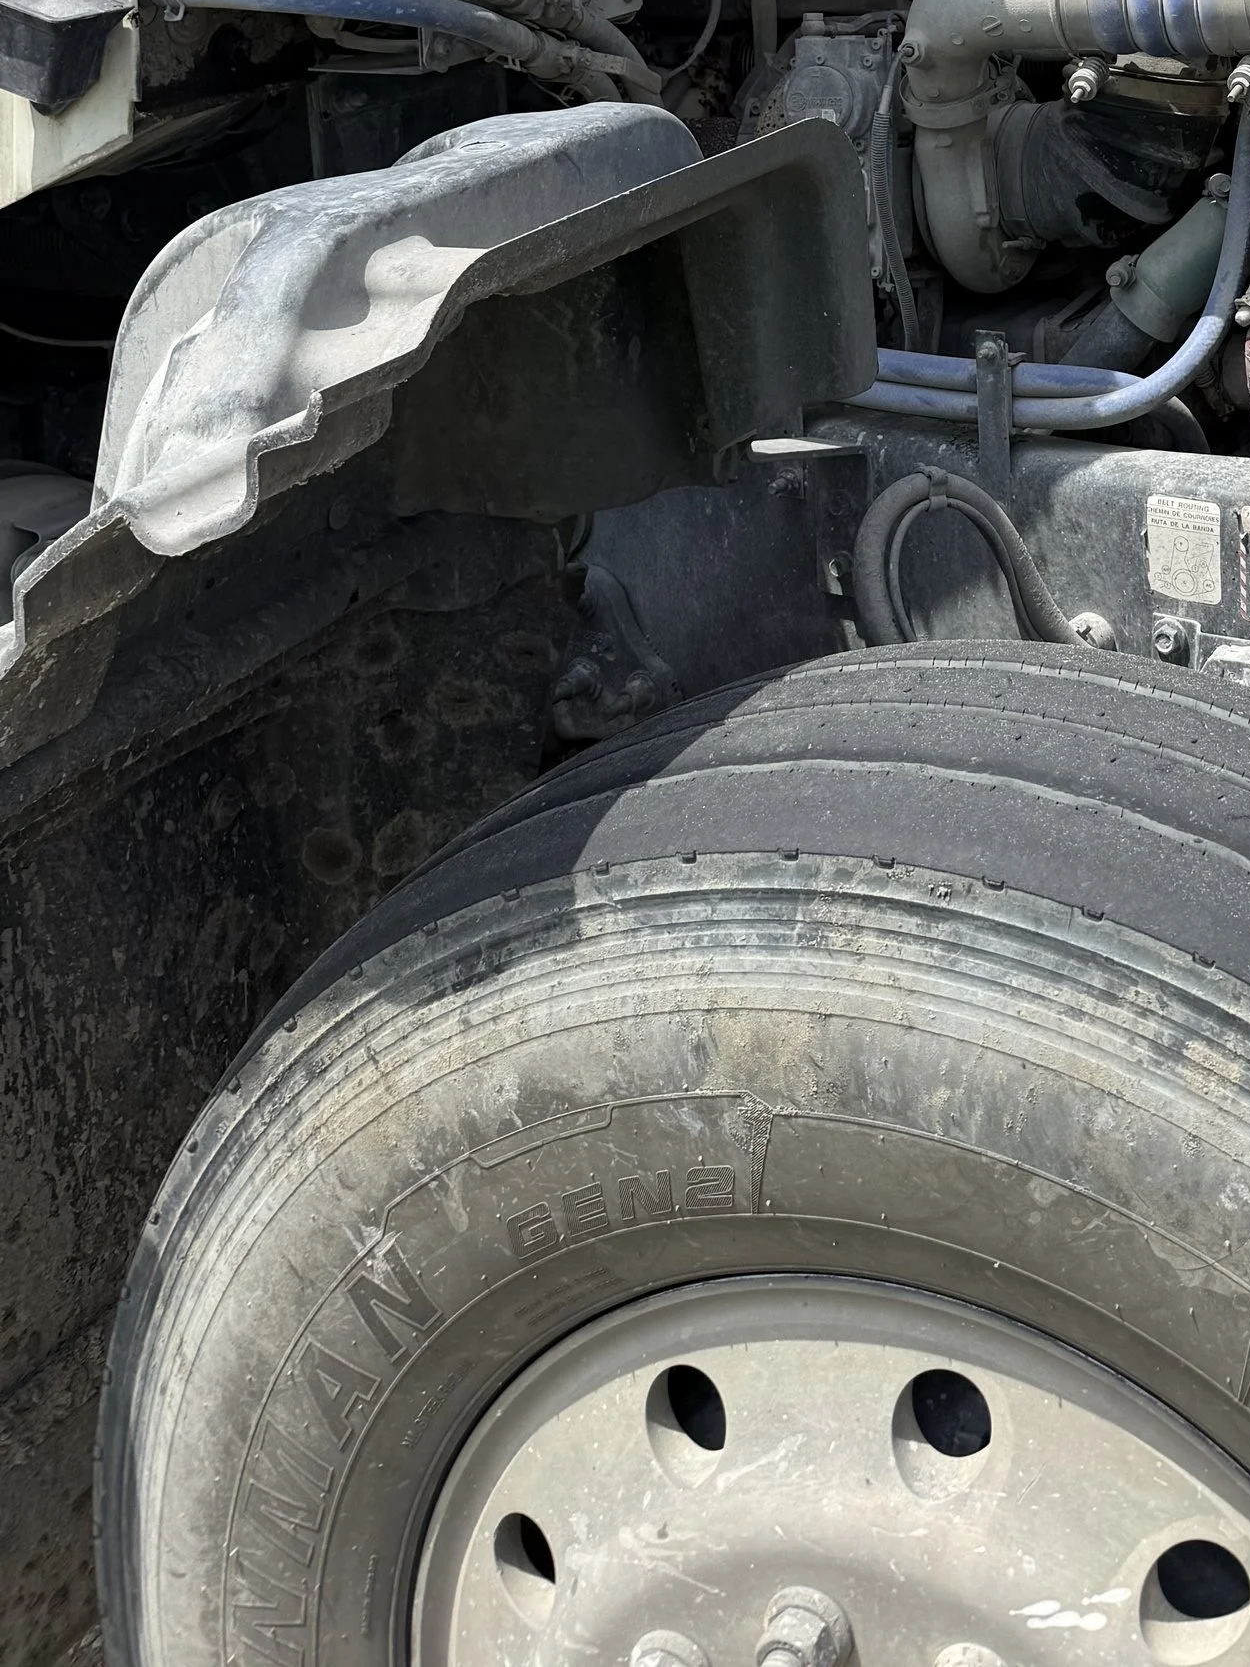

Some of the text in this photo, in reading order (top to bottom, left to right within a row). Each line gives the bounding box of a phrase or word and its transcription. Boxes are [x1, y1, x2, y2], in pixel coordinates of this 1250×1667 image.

[1157, 498, 1210, 513] BELT ROUTING
[1192, 525, 1215, 533] BANDA
[506, 1164, 736, 1260] GEN2
